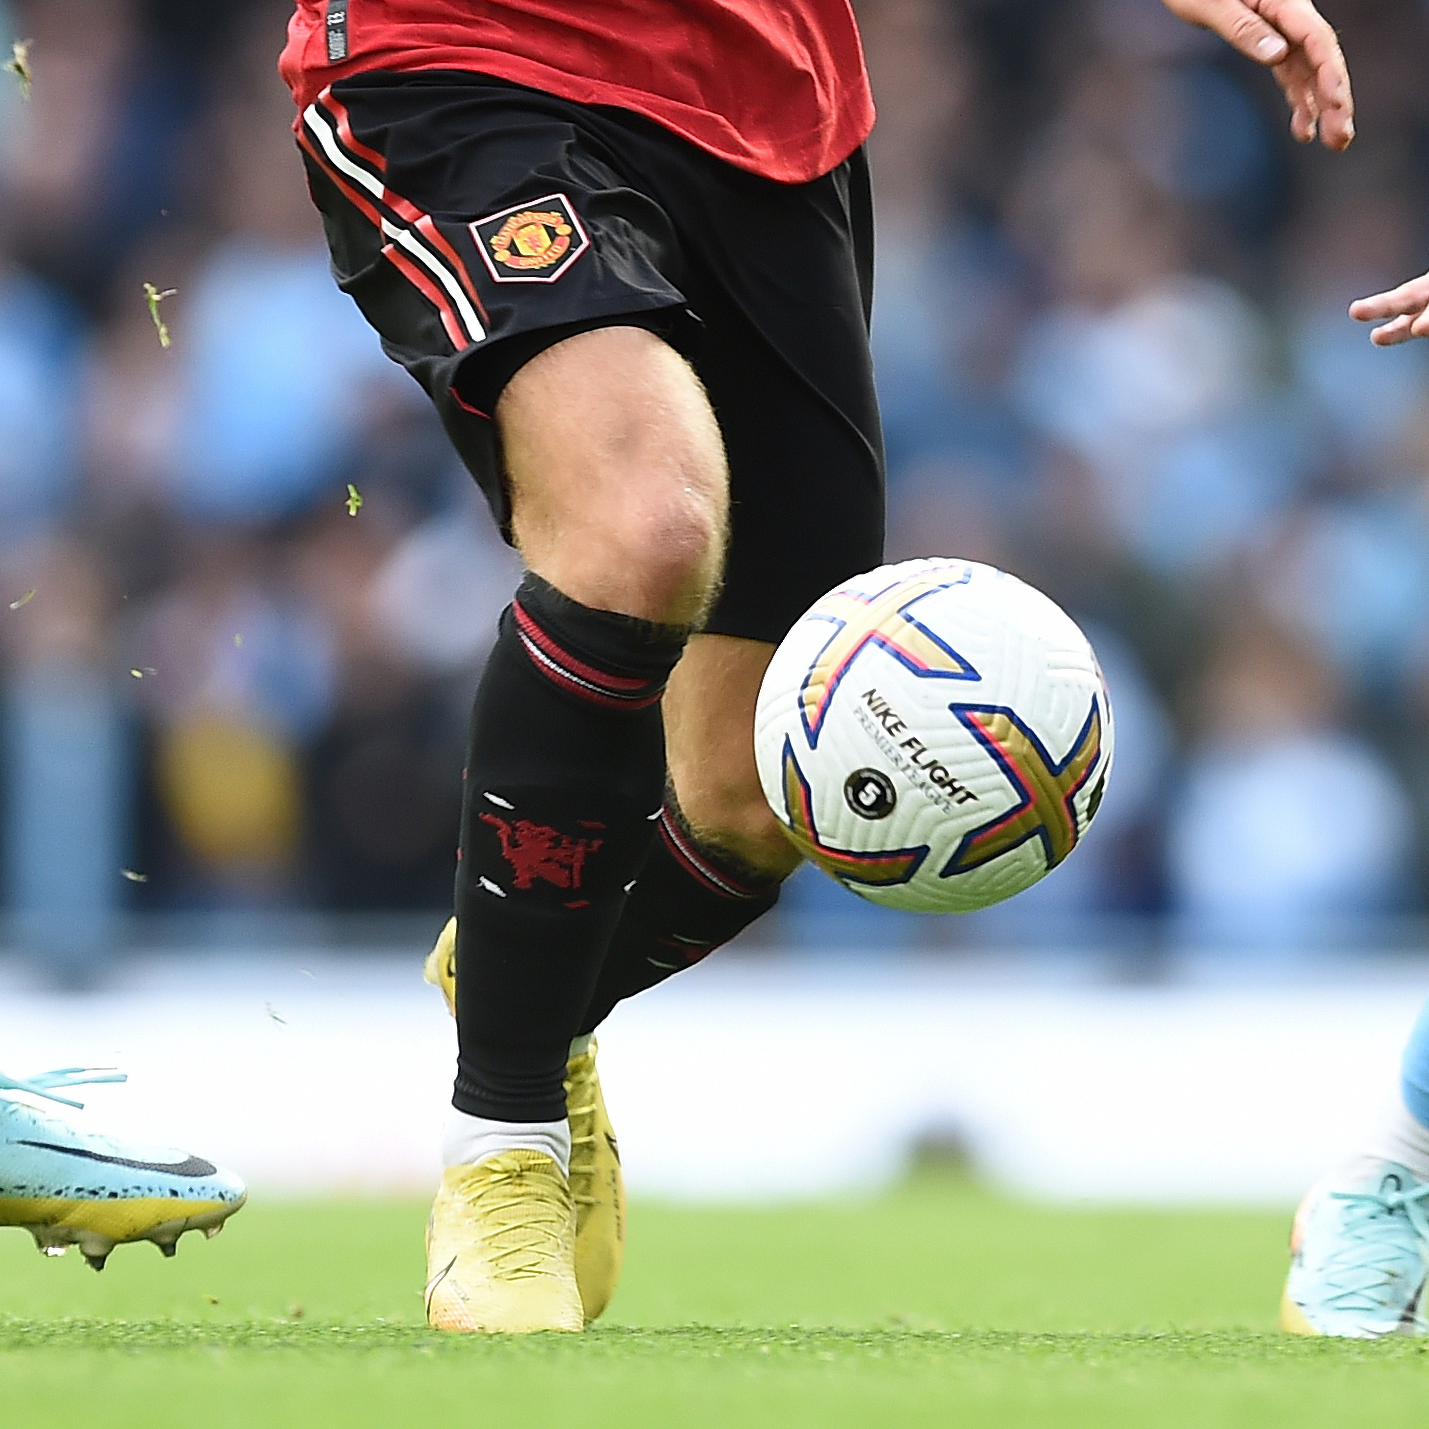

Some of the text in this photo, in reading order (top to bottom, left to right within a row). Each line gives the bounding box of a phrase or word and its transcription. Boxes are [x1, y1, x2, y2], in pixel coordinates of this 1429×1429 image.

[852, 705, 953, 815] PREMIER LEAGUE
[858, 781, 882, 806] 5
[860, 688, 980, 805] NIKE FLIGHT
